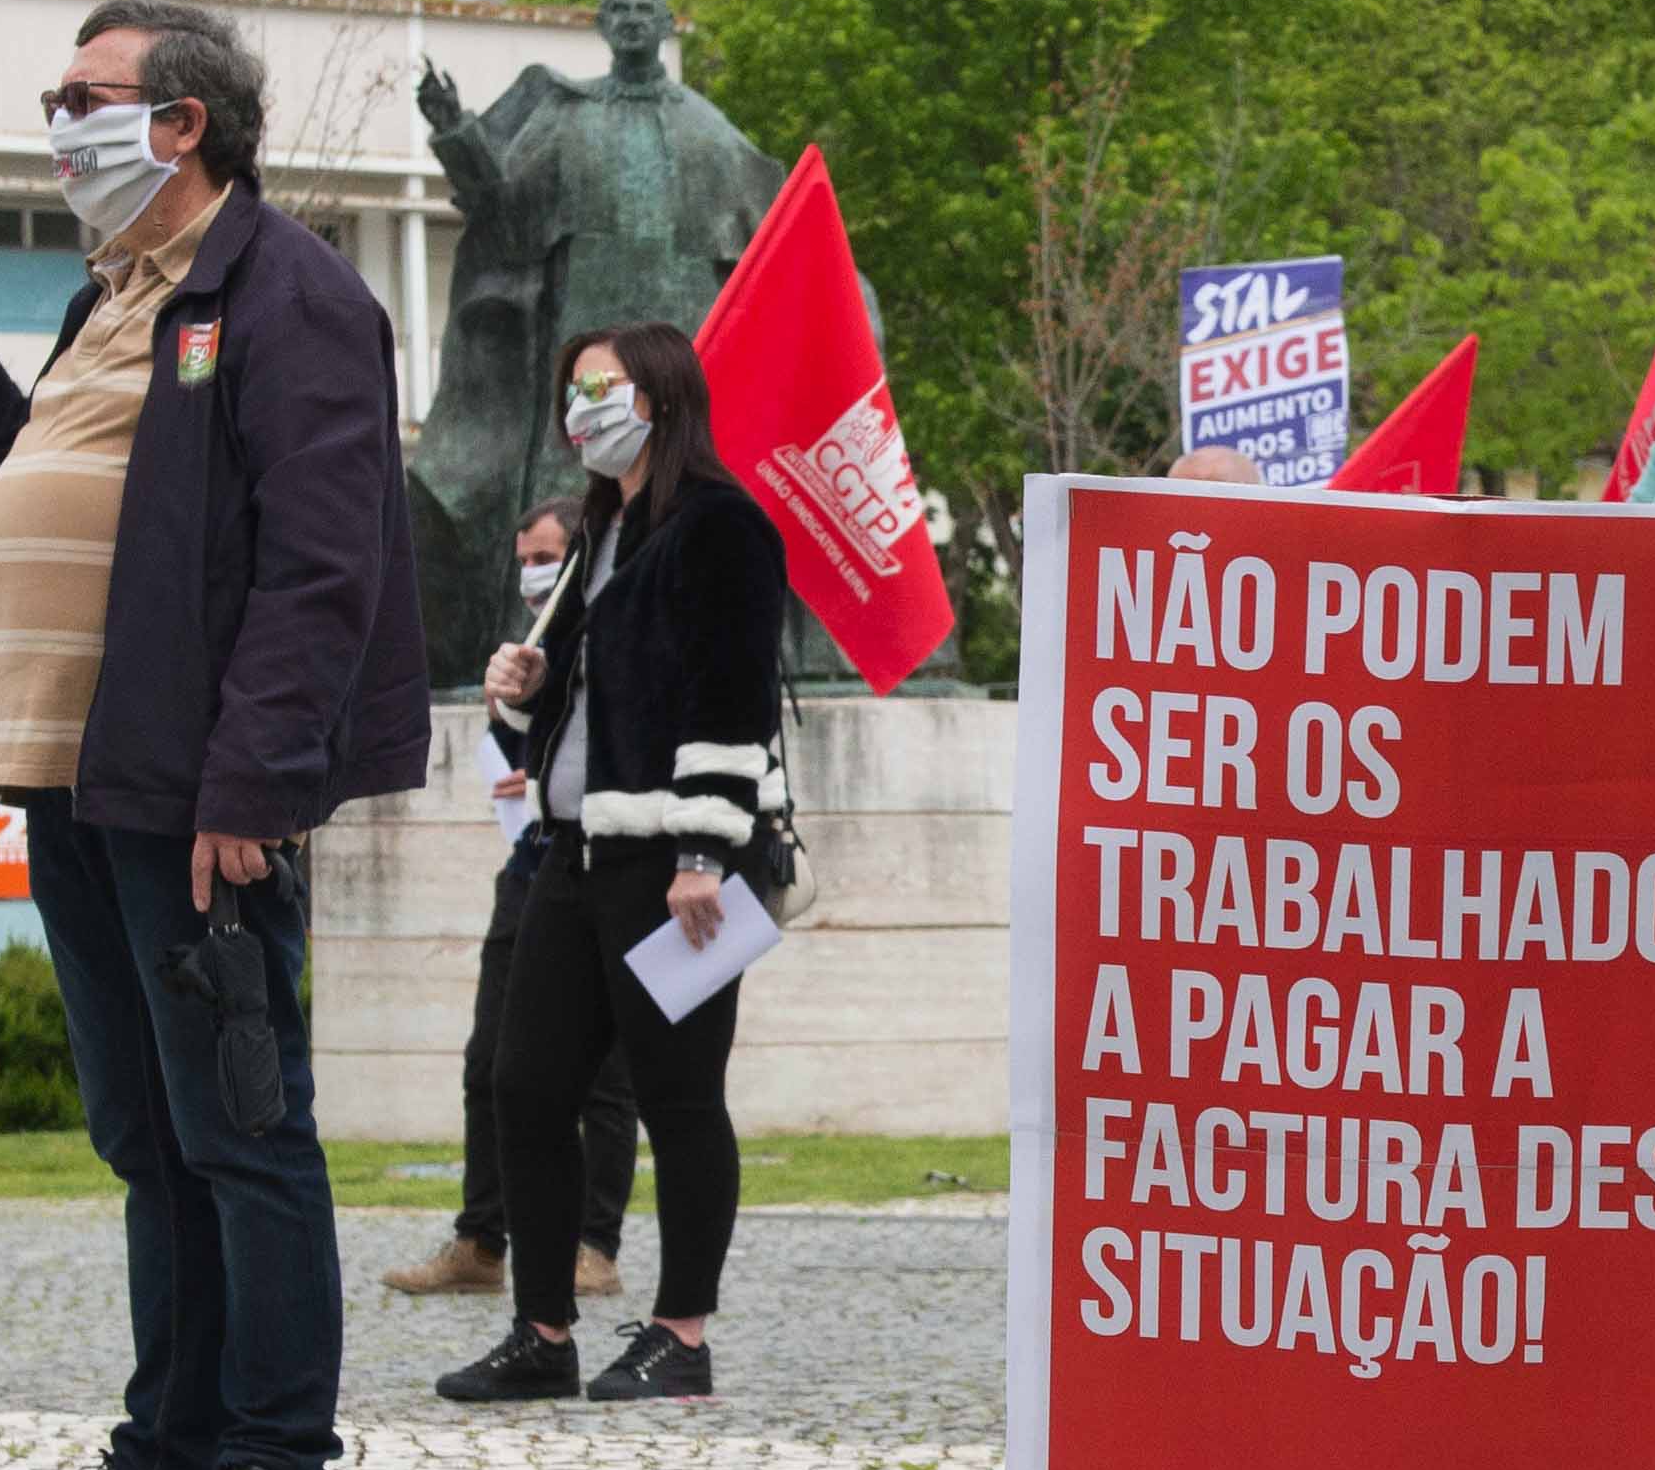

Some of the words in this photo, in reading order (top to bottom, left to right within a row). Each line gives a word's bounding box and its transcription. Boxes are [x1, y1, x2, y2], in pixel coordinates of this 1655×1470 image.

[1186, 271, 1310, 344] STAL
[1189, 326, 1344, 403] EXIGE
[1197, 387, 1334, 440] AUMENTO
[816, 440, 899, 533] CGTP
[1096, 530, 1276, 673] NÃO
[1305, 562, 1625, 686] PODEM
[1088, 686, 1258, 810] SER
[1286, 706, 1403, 819] OS
[1083, 963, 1142, 1077] A
[1171, 970, 1465, 1098] PAGAR
[1494, 987, 1554, 1099] A
[1085, 1099, 1487, 1228] FACTURA
[1080, 1228, 1546, 1377] SITUAÇÃO!
